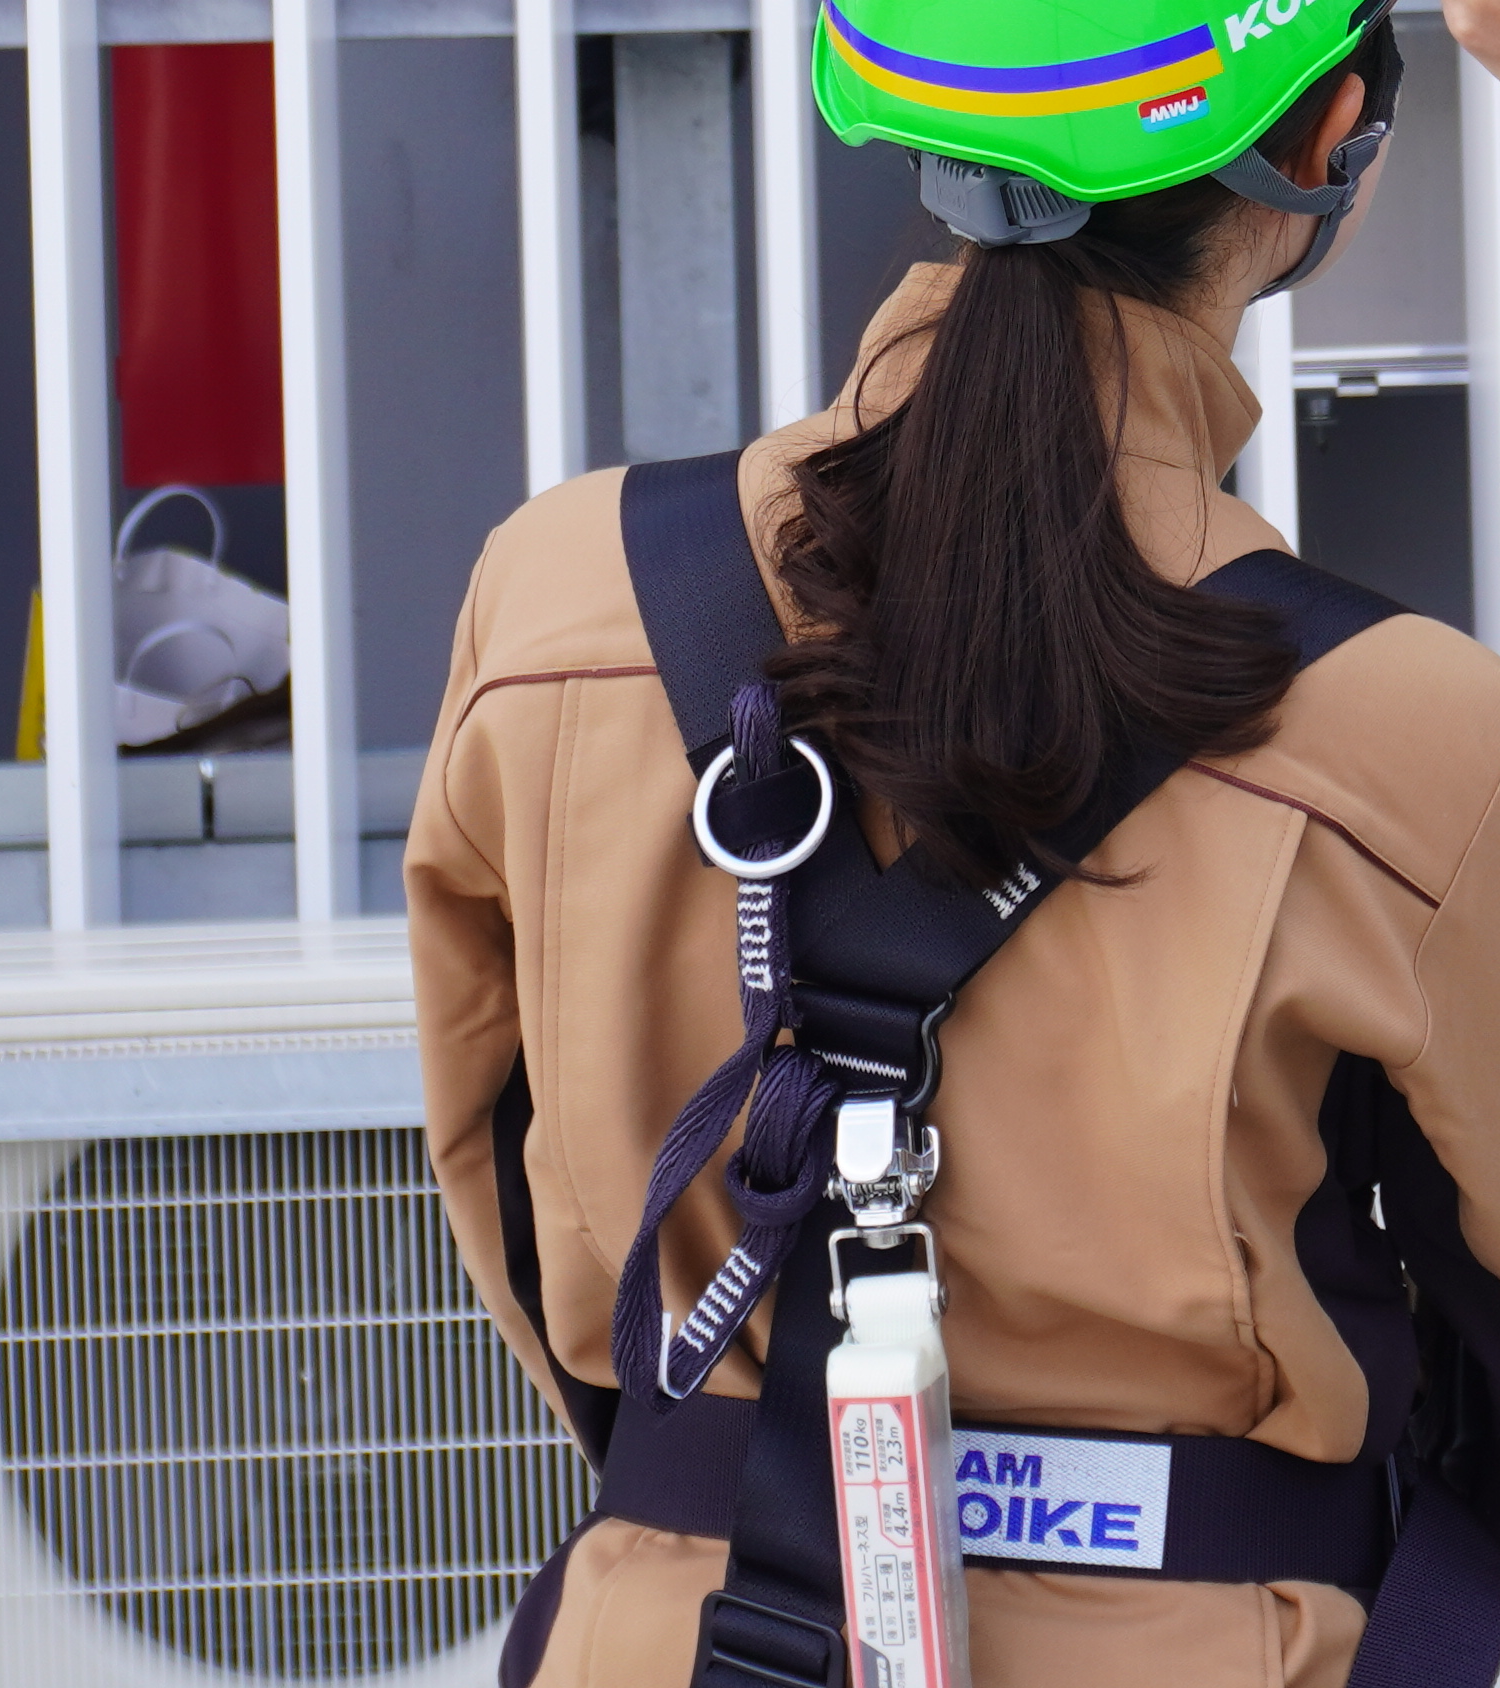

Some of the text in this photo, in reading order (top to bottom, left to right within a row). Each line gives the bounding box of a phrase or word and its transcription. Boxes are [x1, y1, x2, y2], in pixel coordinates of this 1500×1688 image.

[1150, 95, 1200, 123] MWJ
[955, 1450, 1042, 1488] AM
[957, 1491, 1143, 1552] OIKE
[855, 1515, 875, 1602] フルハーネス型
[879, 1563, 895, 1602] 第一種
